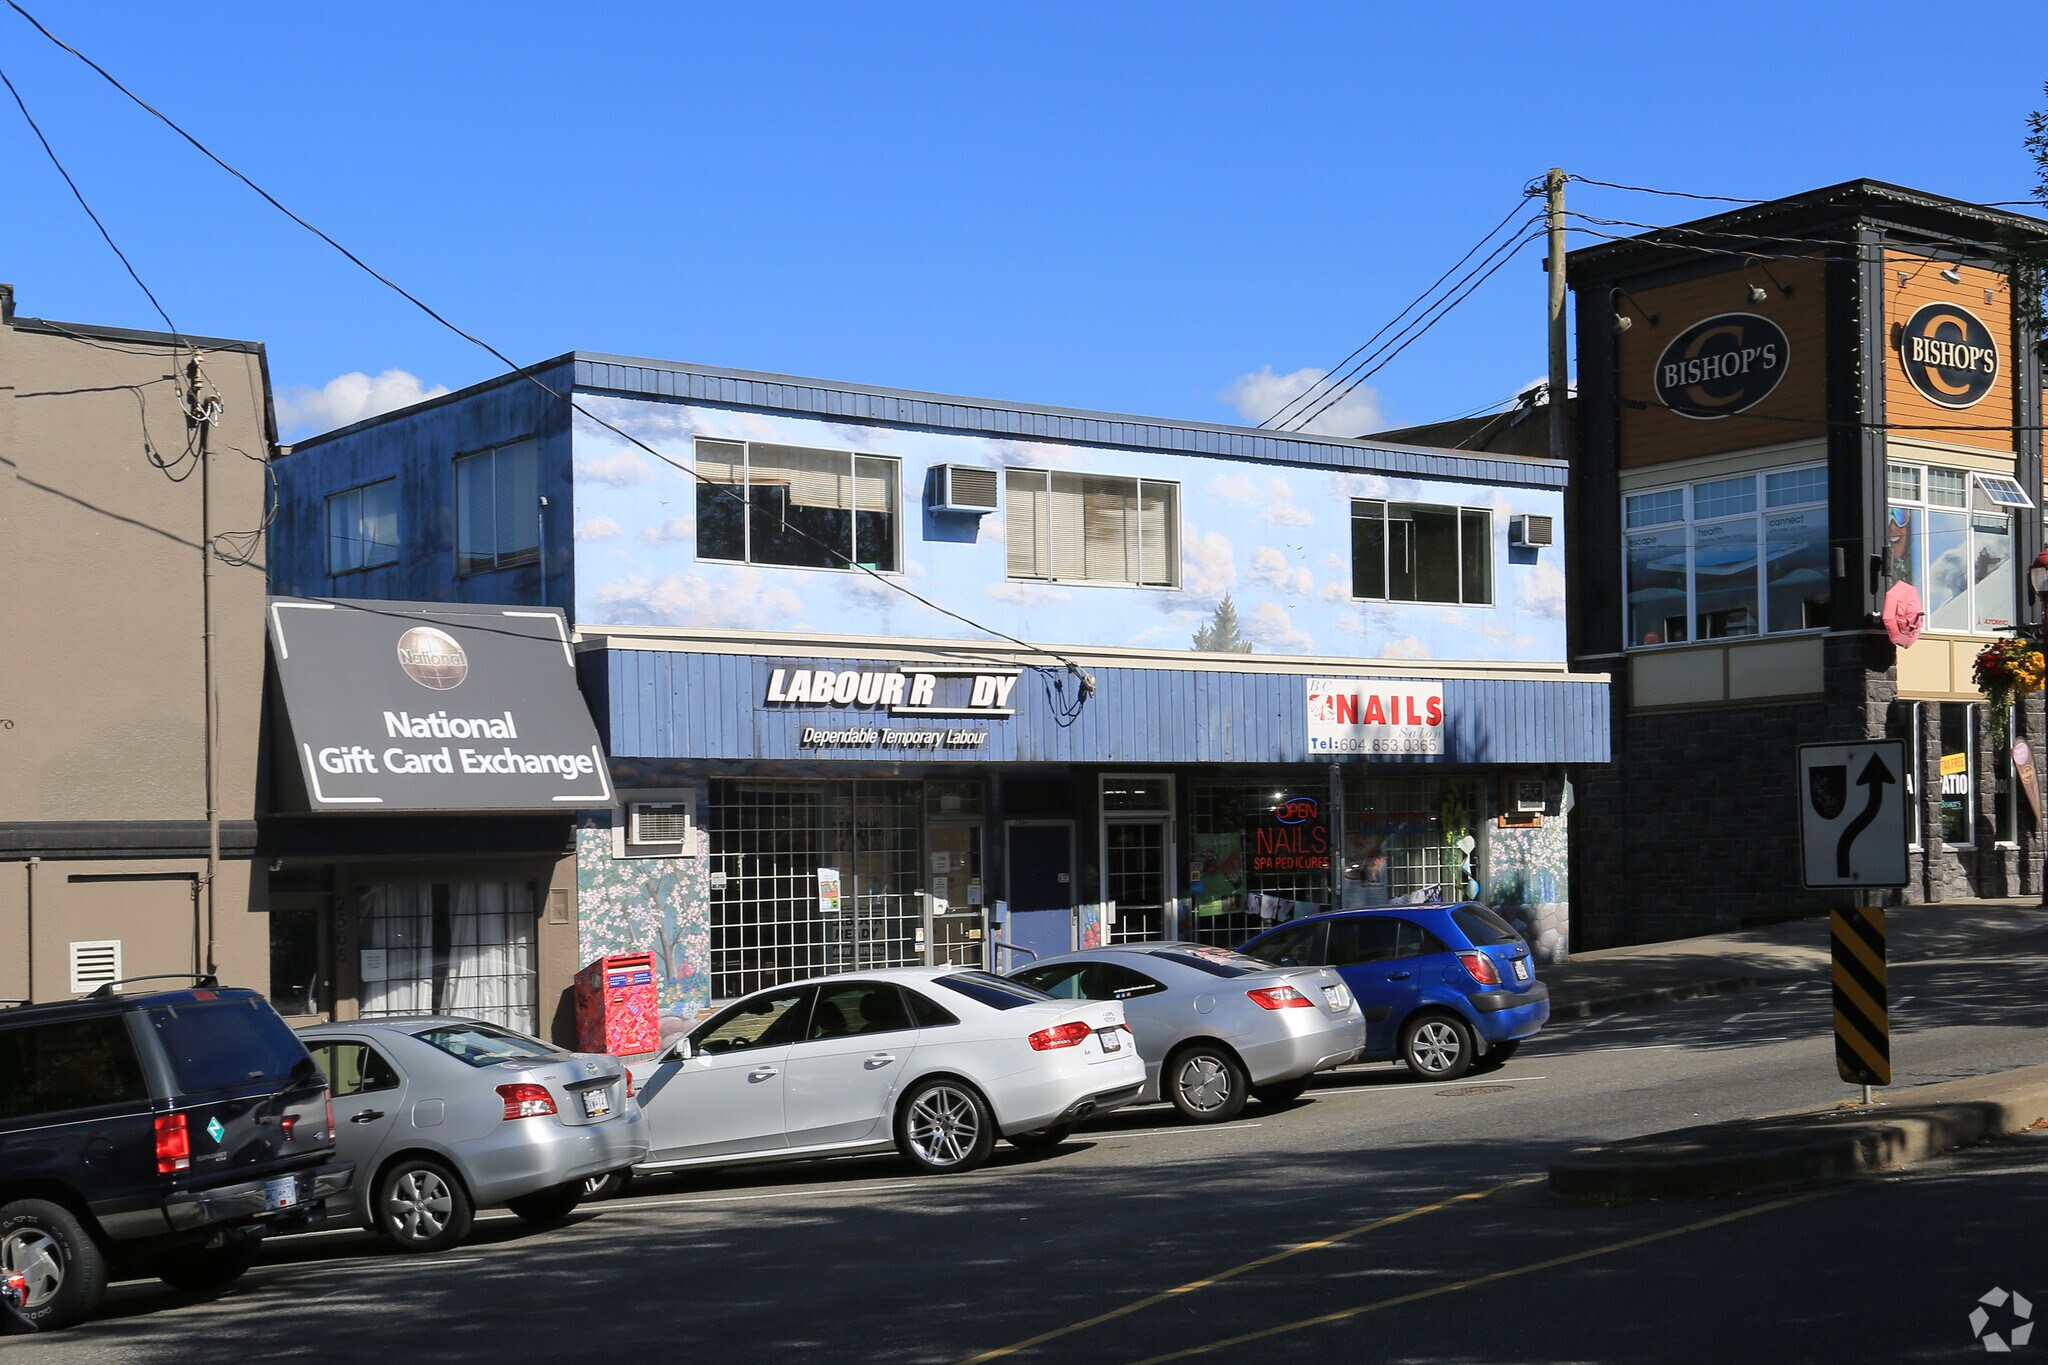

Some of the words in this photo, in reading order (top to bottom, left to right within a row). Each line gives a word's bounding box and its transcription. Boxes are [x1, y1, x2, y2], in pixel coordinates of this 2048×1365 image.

[1912, 337, 1994, 374] BISHOP'S
[1664, 343, 1777, 389] BISHOP'S
[1769, 515, 1804, 527] connect
[1629, 535, 1657, 547] escape
[1697, 526, 1723, 537] health
[400, 648, 468, 667] National
[767, 668, 905, 706] LABOUR
[1309, 680, 1333, 692] BC
[1336, 694, 1442, 727] NAILS
[383, 710, 519, 739] National
[1399, 726, 1442, 739] Salon
[802, 727, 879, 746] Dependable
[881, 727, 945, 748] Temporary
[946, 729, 988, 746] Labour
[318, 746, 380, 774] Gift
[383, 747, 454, 775] Card
[458, 748, 594, 781] Exchange
[1951, 756, 1964, 768] FREE
[1277, 803, 1318, 818] OPEN
[1257, 825, 1328, 855] NAILS
[1254, 857, 1273, 870] SPA
[1275, 856, 1330, 869] PEDICURES
[335, 896, 347, 963] 2568
